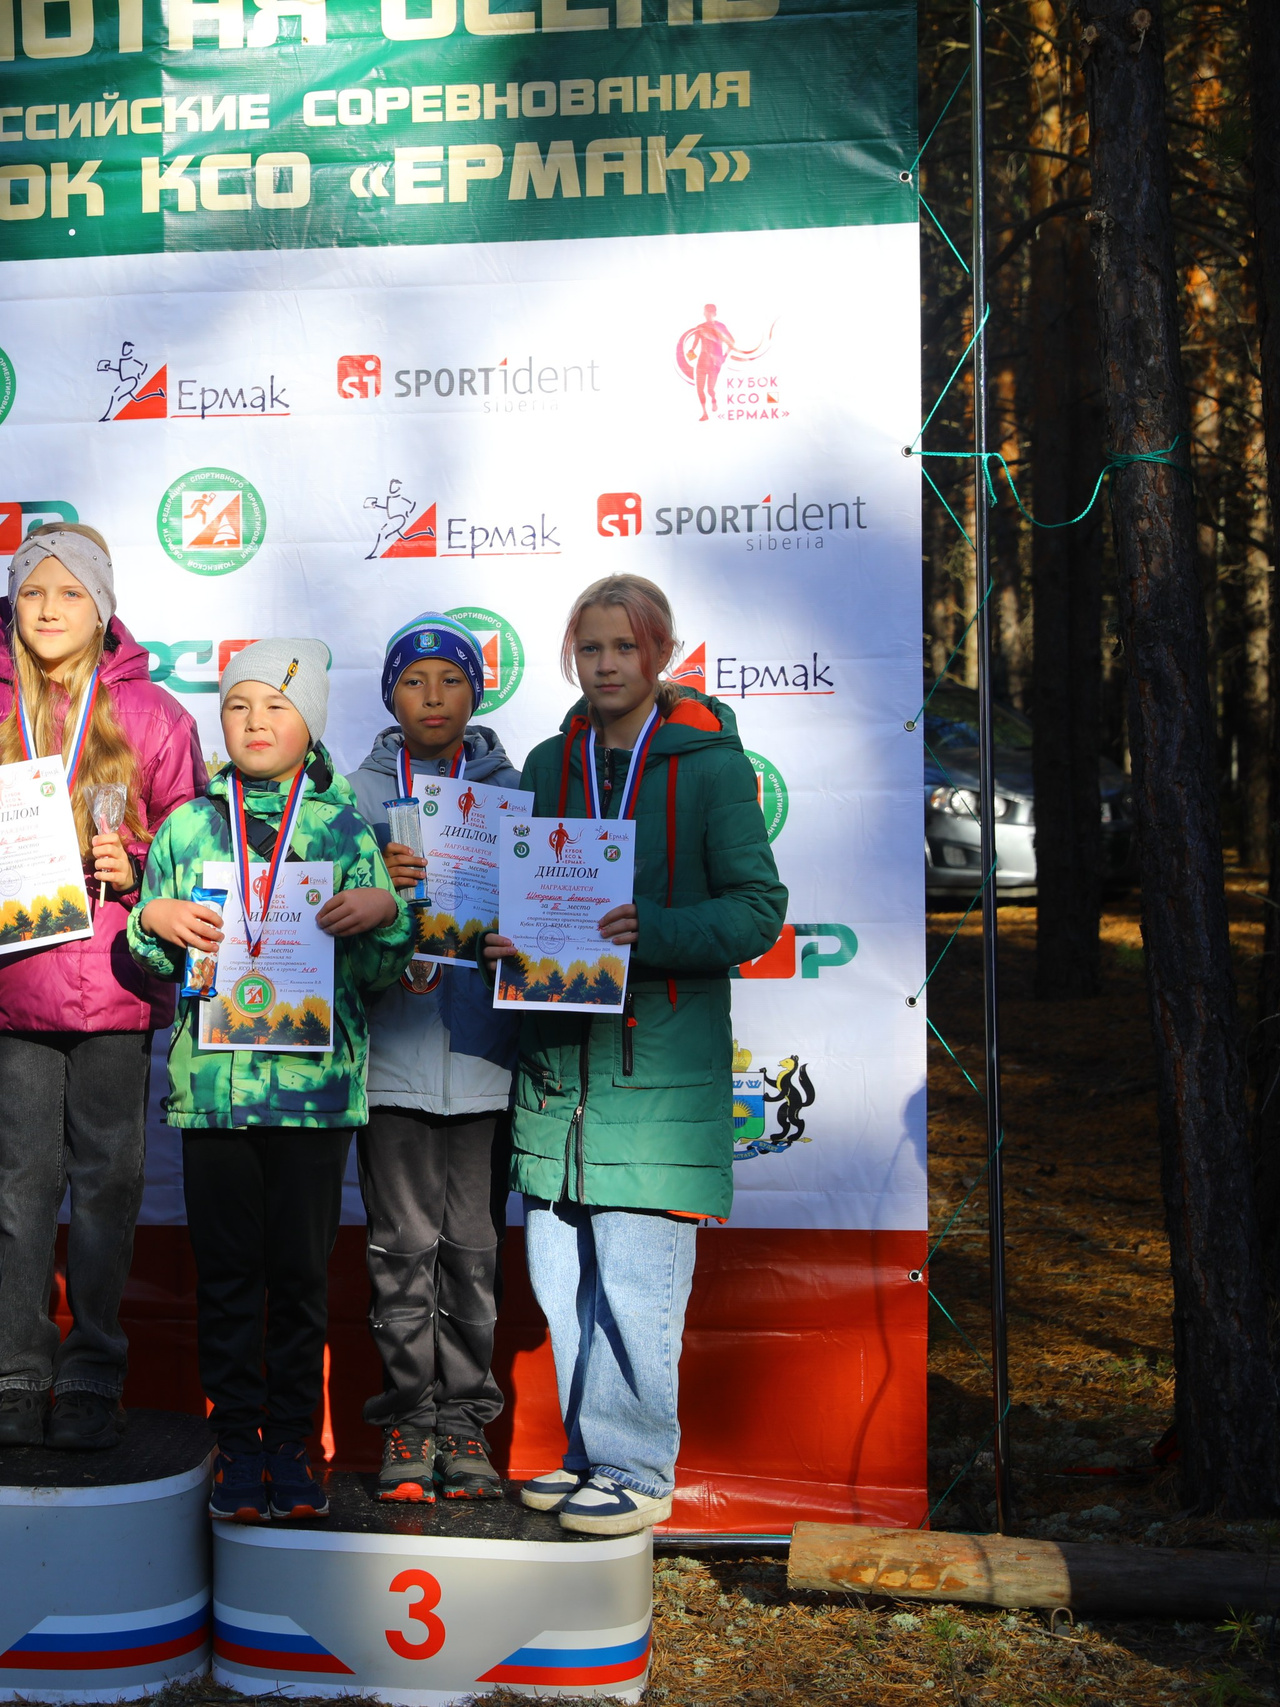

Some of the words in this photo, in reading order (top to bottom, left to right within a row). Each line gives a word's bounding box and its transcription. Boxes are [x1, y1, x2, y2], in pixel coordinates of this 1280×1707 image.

[302, 70, 751, 127] СОРЕВНОВАНИЯ
[141, 152, 311, 214] КСО
[349, 133, 751, 205] «ЕРМАК»
[394, 356, 601, 398] SPORTident
[726, 375, 779, 388] КУБОК
[178, 375, 290, 420] Ермак
[726, 393, 762, 405] КСО
[717, 407, 791, 421] «ЕРМАК»
[190, 472, 244, 489] СПОРТИВНОГО
[655, 493, 867, 536] SPORTident
[447, 514, 561, 558] Ермак
[746, 534, 824, 551] siberia
[450, 612, 502, 628] ПОРТИВНОГО
[498, 632, 519, 699] ОРИЕНТИРОВАНИЯ
[717, 651, 834, 698] Ермак
[440, 825, 498, 844] ДИПЛОМ
[444, 842, 493, 856] НАГРАЖДАЕТСЯ
[468, 865, 488, 873] место
[534, 866, 599, 879] ДИПЛОМ
[540, 884, 594, 892] НАГРАЖДАЕТСЯ
[385, 1568, 446, 1660] 3
